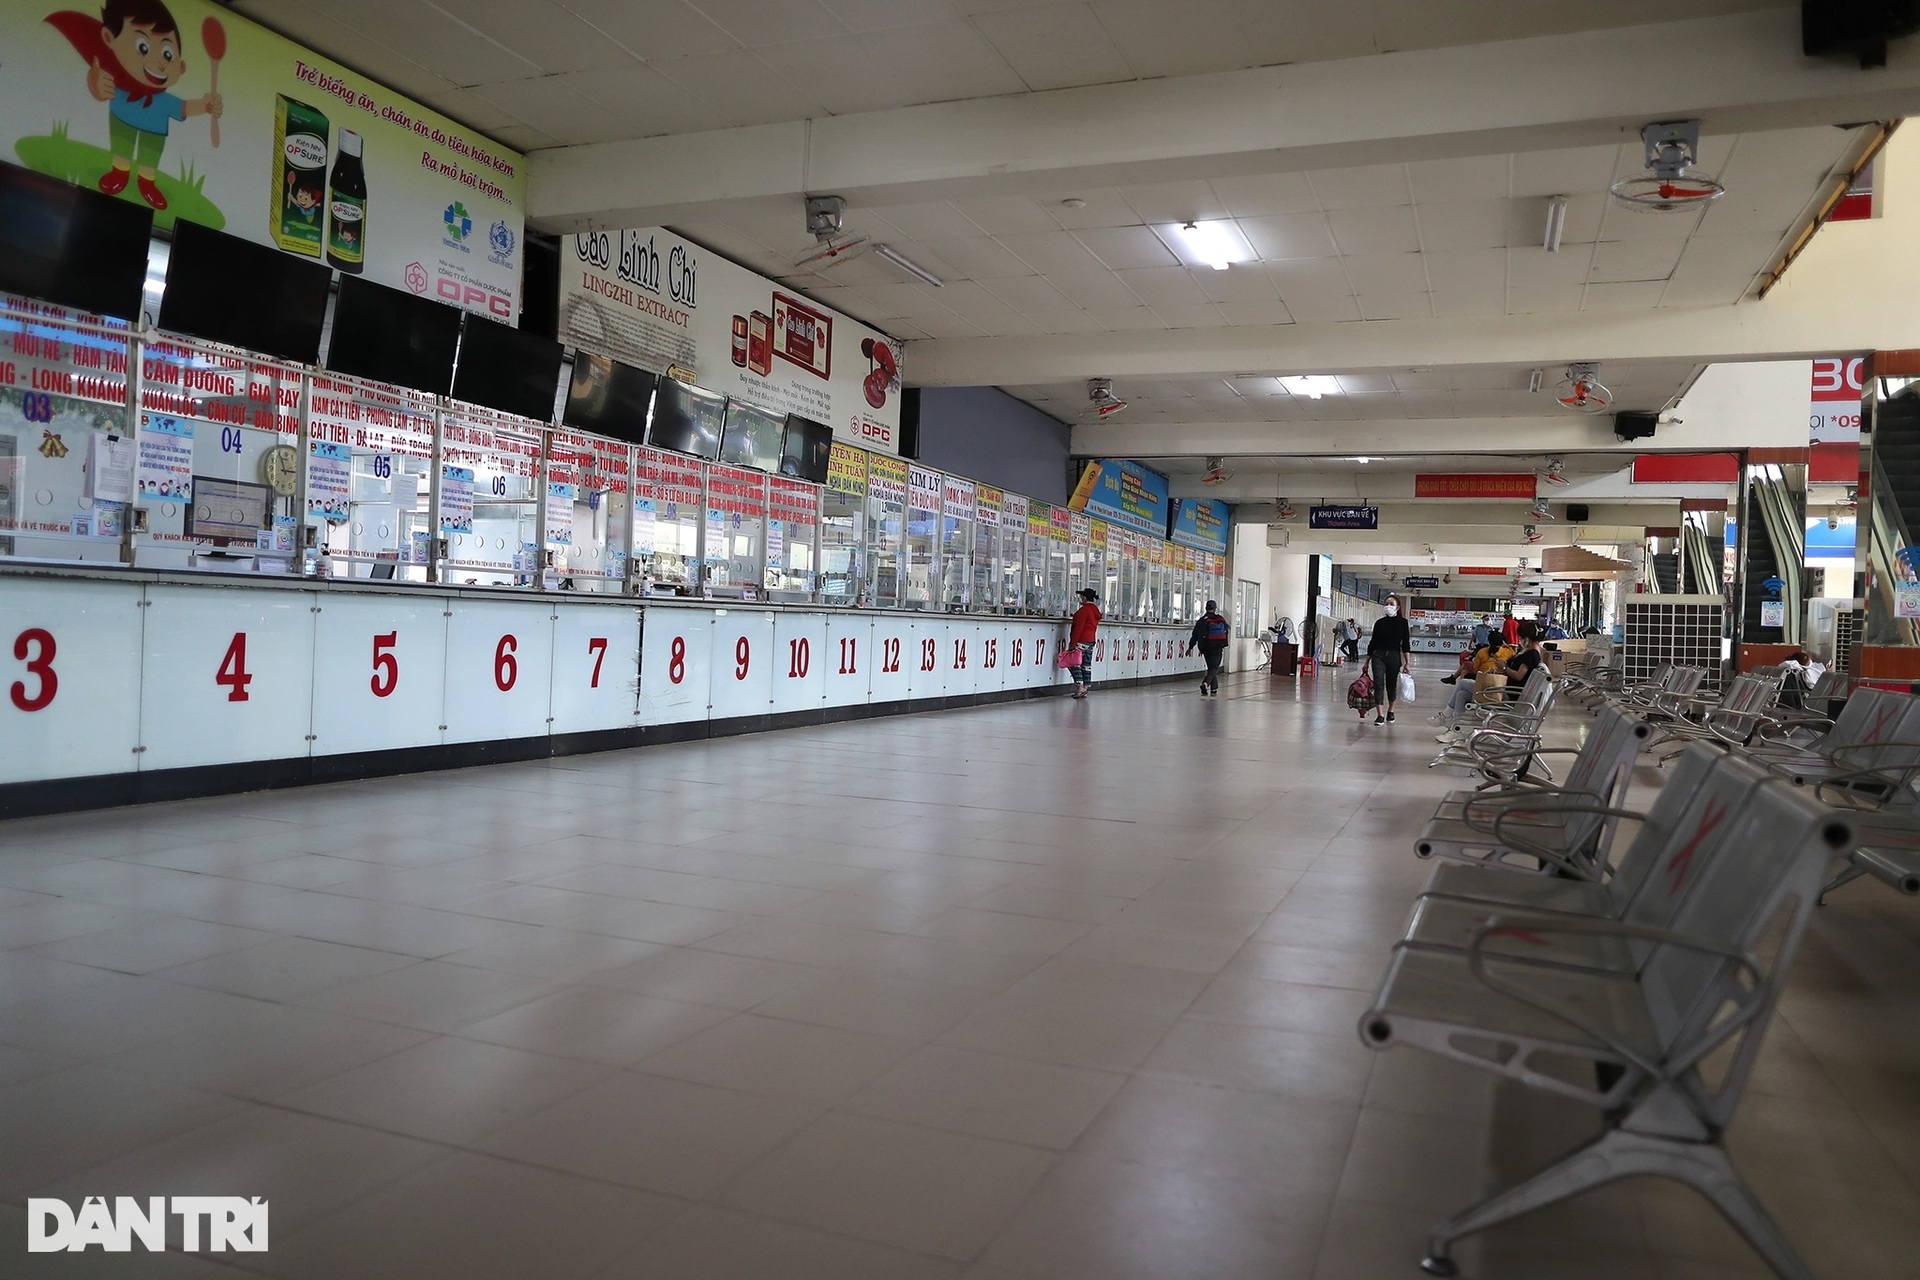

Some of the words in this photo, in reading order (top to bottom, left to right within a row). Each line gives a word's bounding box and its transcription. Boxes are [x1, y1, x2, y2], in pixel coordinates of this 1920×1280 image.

[295, 60, 316, 81] Trẻ
[319, 73, 355, 105] biếng
[357, 94, 378, 116] ăn,
[381, 106, 411, 129] chán
[413, 120, 429, 137] ăn
[431, 129, 445, 144] do
[447, 135, 469, 154] tiêu
[470, 148, 491, 167] hóa
[492, 157, 514, 178] kém
[421, 151, 437, 169] Ra
[440, 162, 457, 178] mồ
[459, 169, 477, 187] hôi
[438, 267, 454, 278] CÔNG
[454, 272, 461, 280] TY
[618, 229, 660, 294] Linh
[669, 245, 698, 308] Chi
[437, 277, 511, 317] OPC
[582, 271, 634, 307] LINGZHI
[637, 293, 690, 328] EXTRACT
[105, 348, 127, 375] TÂN
[32, 367, 72, 395] LONG
[77, 375, 126, 404] KHÁNH
[183, 367, 234, 397] ĐƯỜNG
[249, 381, 272, 404] GIA
[276, 386, 300, 409] RAY
[23, 391, 51, 423] 03
[143, 388, 173, 411] XUÂN
[176, 392, 197, 420] LỘC
[311, 395, 328, 415] NAM
[330, 396, 345, 418] CÁT
[221, 426, 242, 453] 04
[311, 418, 328, 440] CÁT
[862, 422, 890, 441] OPC
[374, 455, 391, 480] 05
[600, 457, 613, 472] TUY
[829, 460, 843, 474] INH
[845, 464, 865, 478] TUẤN
[854, 451, 864, 464] HÀ
[887, 459, 907, 472] LONG
[491, 476, 506, 495] 06
[909, 470, 926, 489] KIM
[929, 473, 941, 493] LÝ
[589, 491, 600, 510] 07
[881, 501, 888, 513] 12
[1318, 510, 1332, 518] KHU
[1332, 510, 1346, 519] VỰC
[838, 636, 858, 675] 11
[881, 637, 901, 674] 12
[919, 637, 937, 672] 13
[952, 638, 968, 671] 14
[983, 637, 999, 670] 15
[1010, 638, 1022, 668] 16
[1034, 638, 1046, 665] 17
[1095, 638, 1105, 662] 20
[1112, 638, 1121, 661] 21
[1127, 639, 1135, 661] 22
[1142, 639, 1150, 660] 23
[1154, 639, 1162, 660] 24
[1411, 640, 1420, 648] 67
[1427, 640, 1436, 648] 68
[1442, 640, 1451, 649] 69
[1459, 641, 1468, 649] 70
[10, 627, 58, 712] 3
[215, 632, 253, 702] 4
[370, 631, 399, 698] 5
[494, 634, 518, 692] 6
[588, 637, 609, 689] 7
[669, 635, 687, 686] 8
[734, 635, 750, 682] 9
[788, 637, 810, 679] 10
